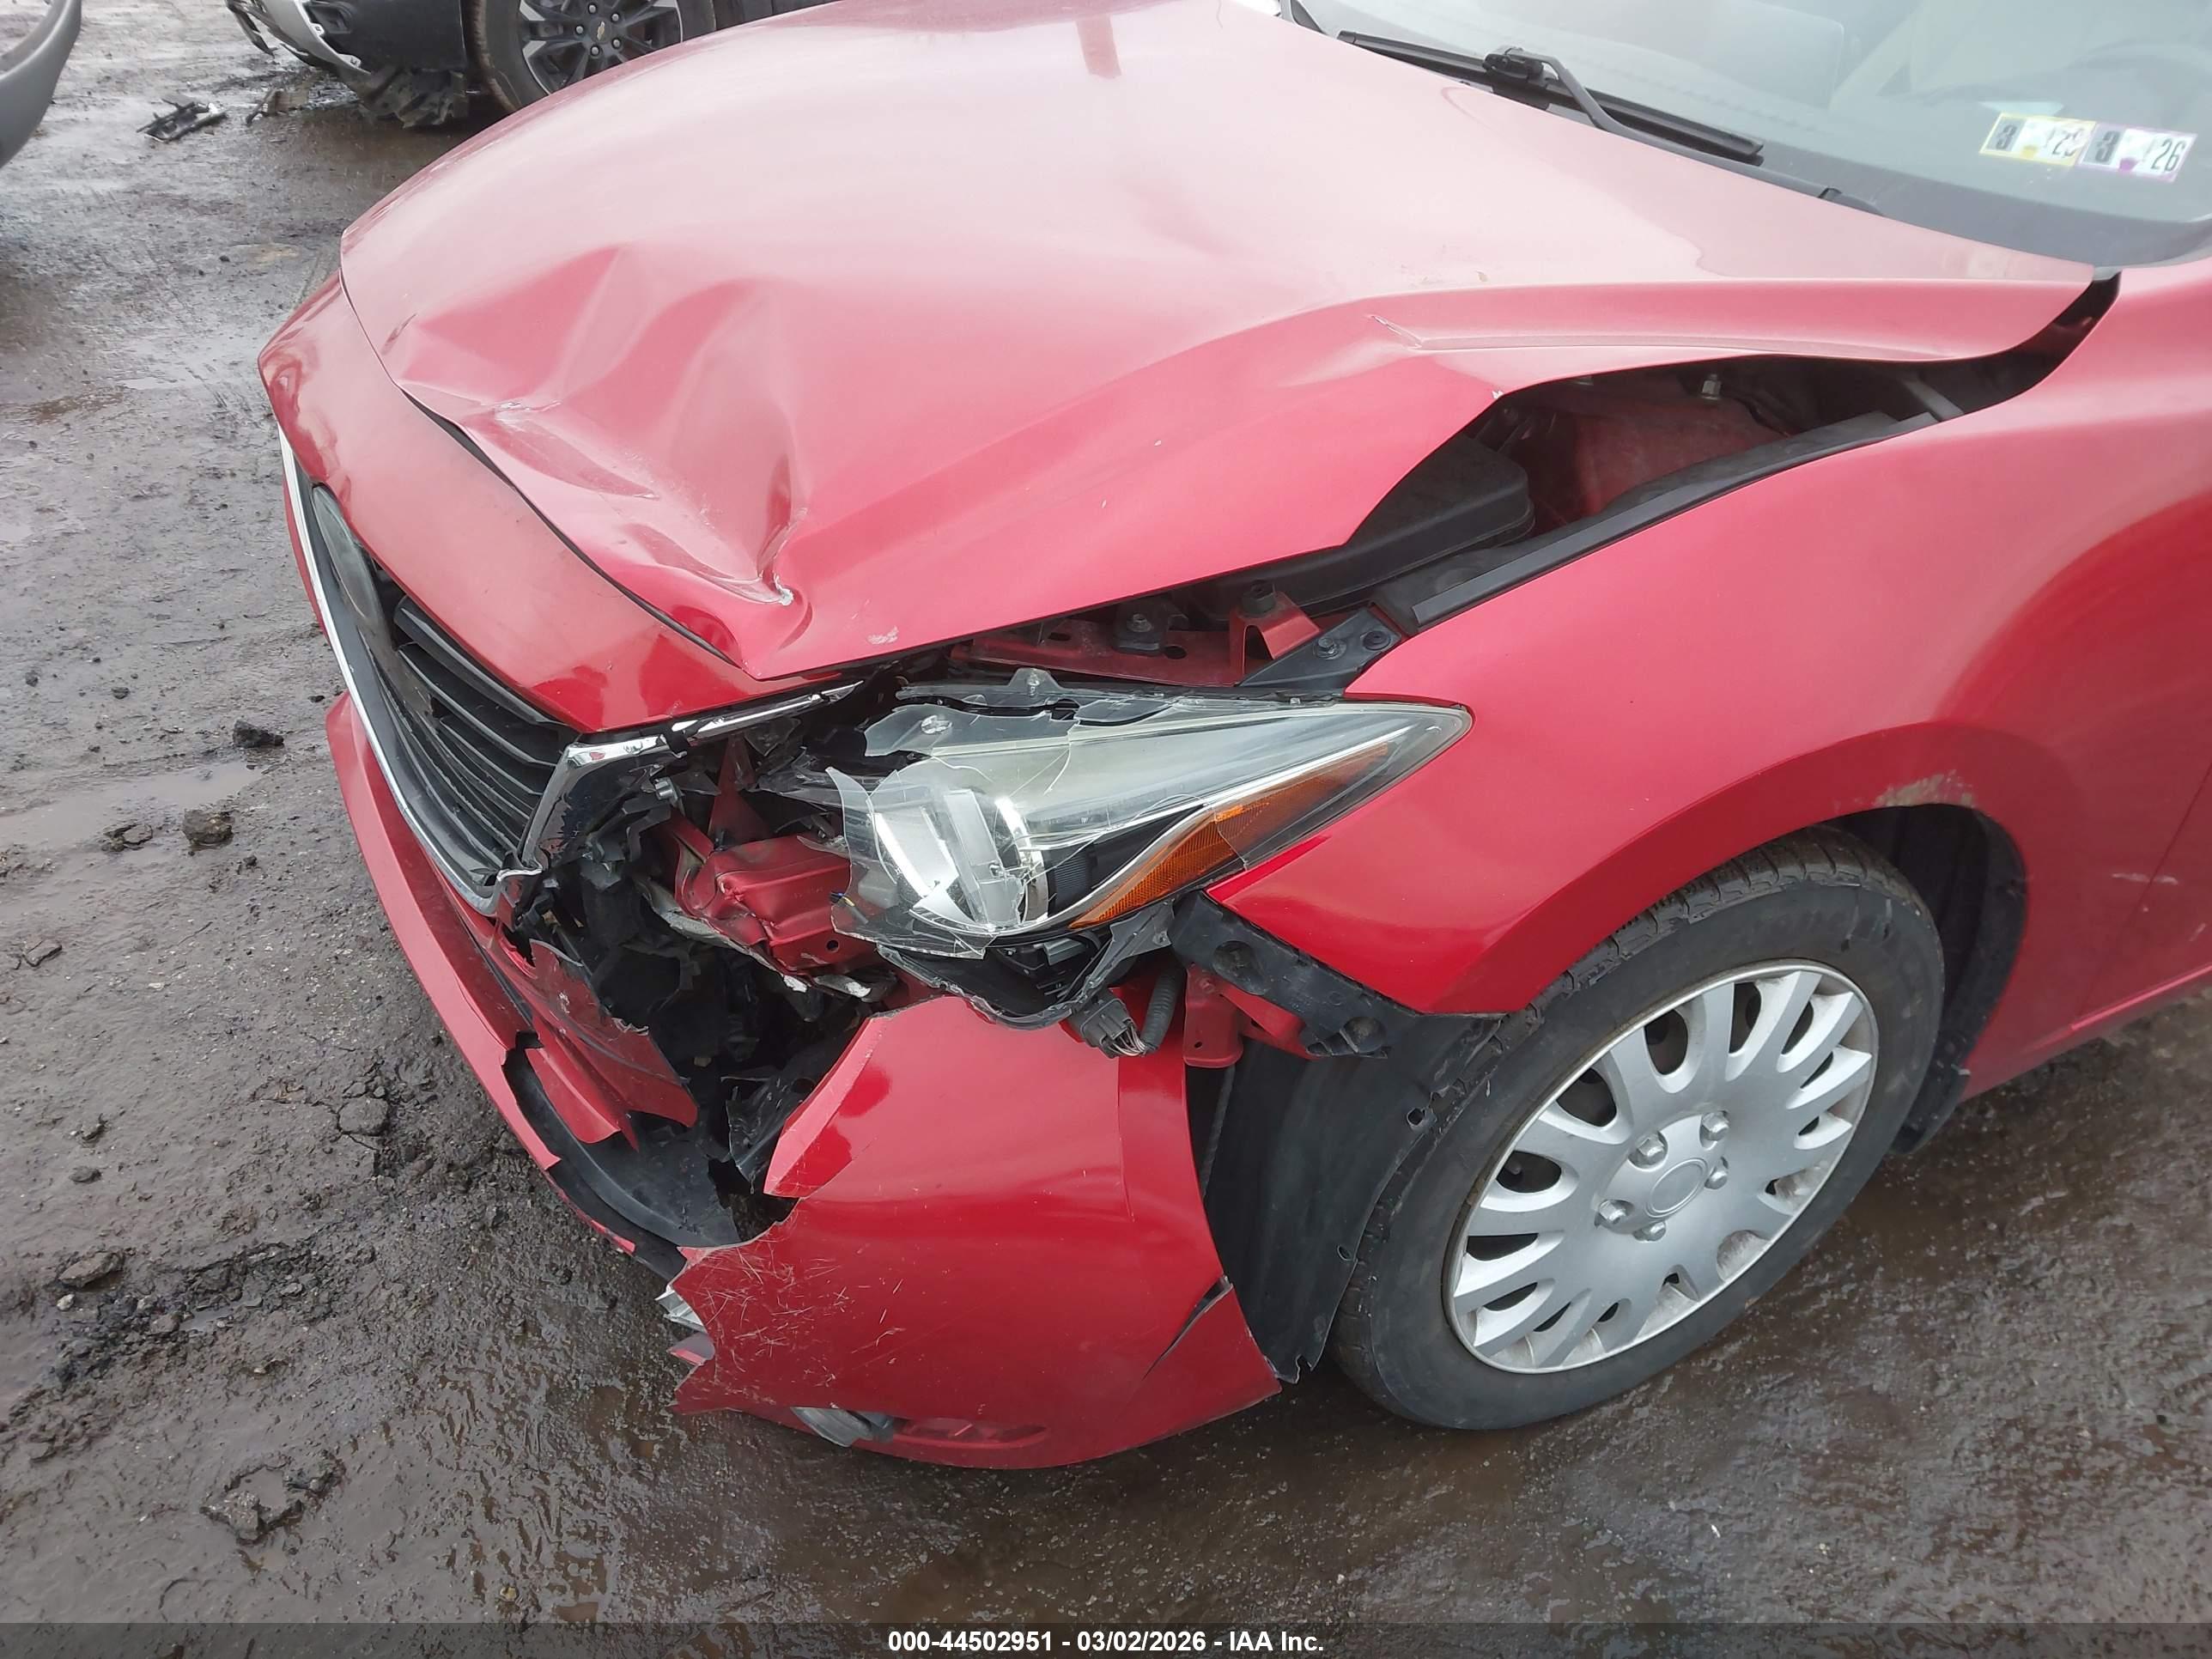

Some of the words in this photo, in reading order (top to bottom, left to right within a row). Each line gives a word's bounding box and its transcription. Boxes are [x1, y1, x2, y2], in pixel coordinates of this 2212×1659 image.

[1995, 124, 2018, 150] 3
[2095, 130, 2121, 163] 3
[2150, 137, 2187, 172] 26
